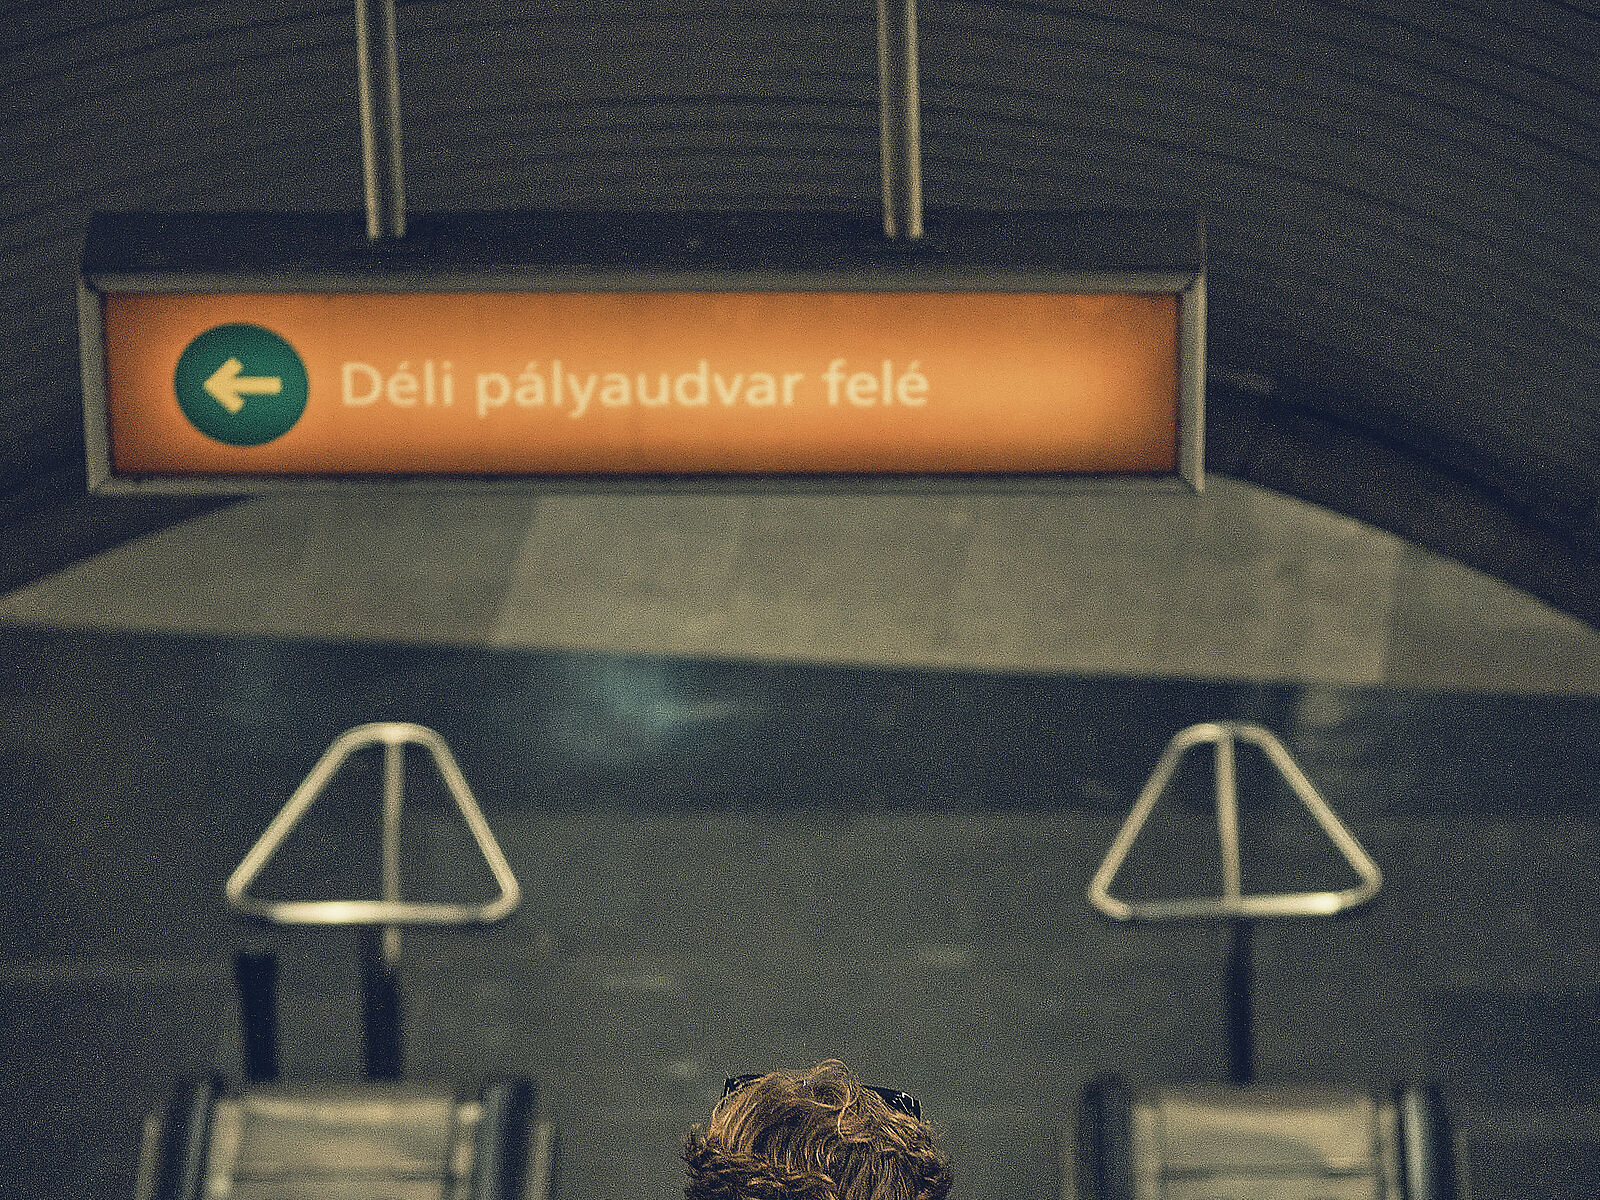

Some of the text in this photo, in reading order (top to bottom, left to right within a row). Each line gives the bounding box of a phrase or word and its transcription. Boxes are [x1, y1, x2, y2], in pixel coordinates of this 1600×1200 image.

[340, 359, 931, 418] Déli pályaudvar felé
